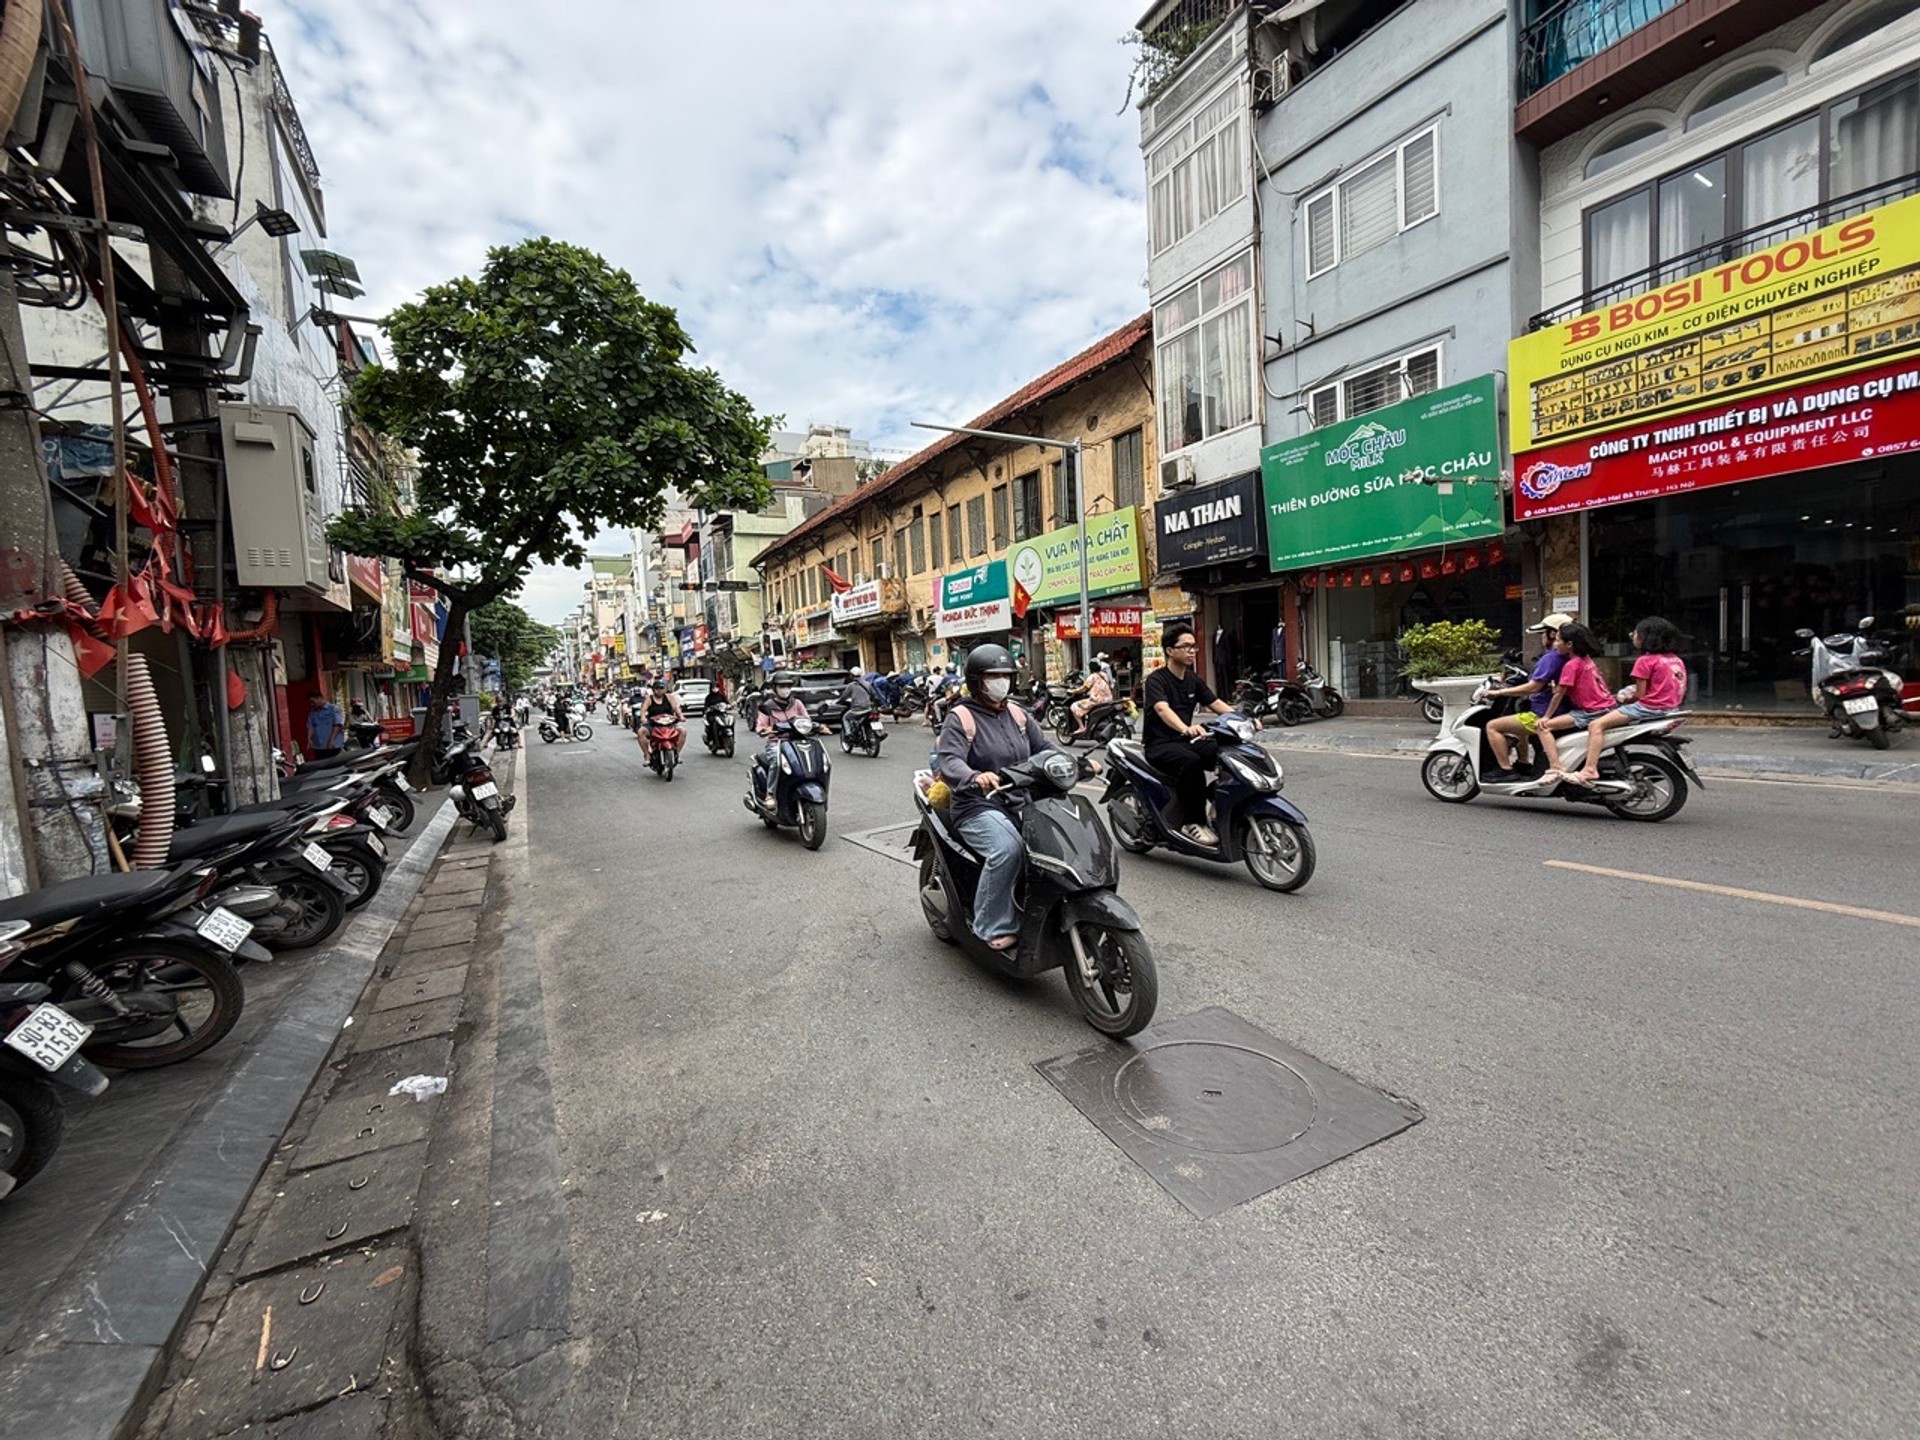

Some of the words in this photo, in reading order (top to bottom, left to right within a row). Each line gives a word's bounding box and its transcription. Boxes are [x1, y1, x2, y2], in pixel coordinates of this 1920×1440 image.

[1609, 278, 1702, 332] BOSI
[1713, 216, 1876, 293] TOOLS
[1560, 351, 1592, 370] DỤNG
[1595, 344, 1612, 359] CỤ
[1644, 326, 1669, 342] KIM
[1682, 314, 1703, 330] CƠ
[1706, 303, 1740, 323] ĐIỆN
[1744, 282, 1809, 311] CHUYÊN
[1814, 257, 1881, 289] NGHIỆP
[1589, 436, 1629, 460] CÔNG
[1631, 433, 1650, 450] TY
[1653, 422, 1696, 446] TNHH
[1698, 407, 1746, 435] THIẾT
[1748, 406, 1768, 425] BỊ
[1772, 397, 1799, 418] VÀ
[1802, 385, 1860, 412] DỤNG
[1863, 376, 1893, 398] CỤ
[1896, 371, 1920, 391] M
[1648, 451, 1688, 465] MACH
[1691, 440, 1728, 456] TOOL
[1730, 436, 1741, 448] &
[1744, 415, 1838, 445] EQUIPMENT
[1841, 408, 1873, 425] LLC
[1270, 498, 1307, 516] THIÊN
[1309, 484, 1360, 507] ĐƯỜNG
[1363, 475, 1395, 494] SỮA
[1441, 451, 1492, 475] CHÂU
[1350, 452, 1385, 471] MILK
[1070, 535, 1094, 554] MA
[1097, 516, 1130, 546] CHẤT
[1164, 510, 1191, 534] NA
[1190, 494, 1242, 527] THAN
[17, 1011, 61, 1048] 90-B3
[35, 1021, 87, 1066] 615.82
